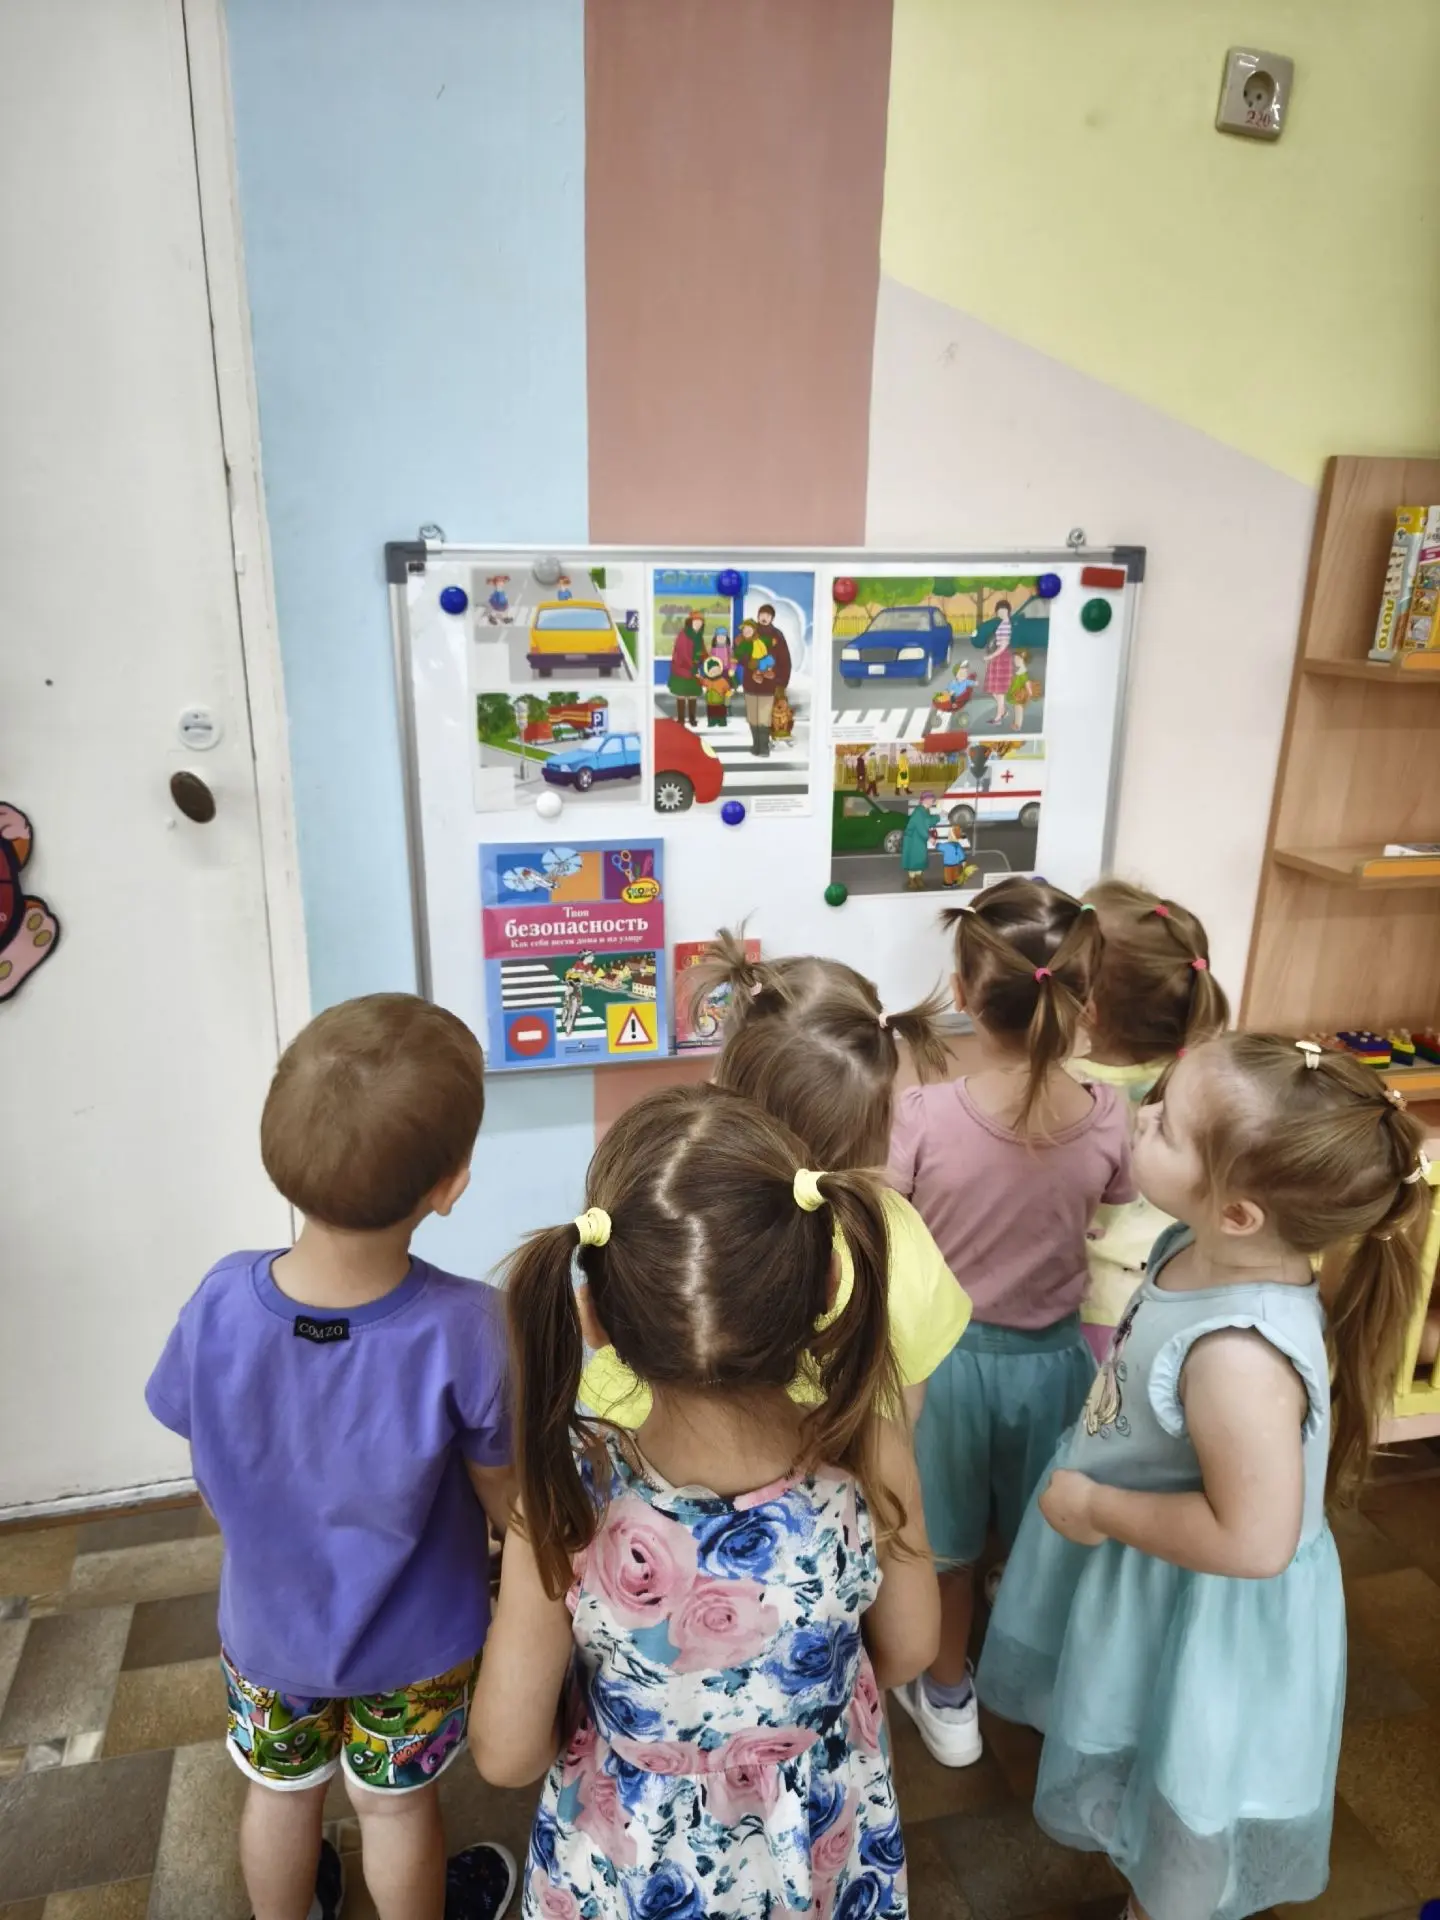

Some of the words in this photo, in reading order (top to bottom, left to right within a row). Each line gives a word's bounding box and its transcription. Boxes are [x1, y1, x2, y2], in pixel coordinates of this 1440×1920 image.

[562, 906, 590, 919] Твоя
[504, 917, 649, 938] безопасность
[510, 939, 529, 949] Как
[530, 938, 549, 948] себя
[619, 934, 644, 945] улице
